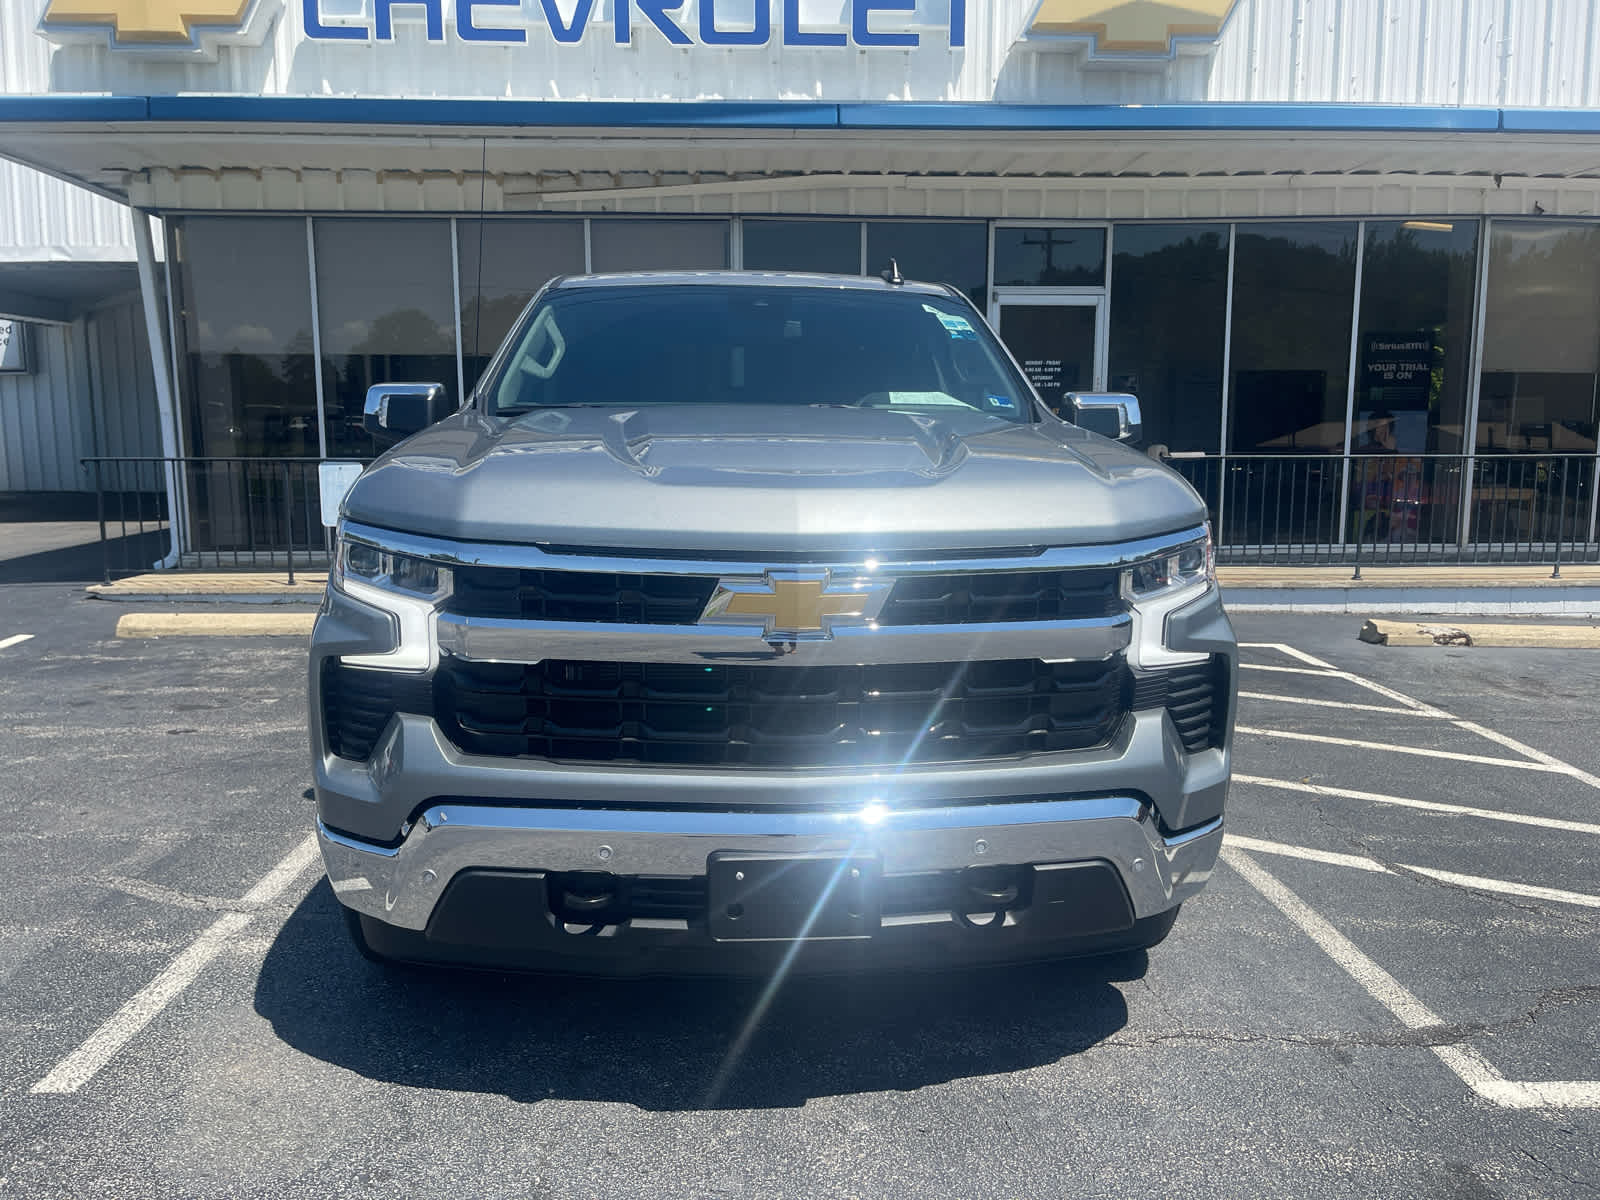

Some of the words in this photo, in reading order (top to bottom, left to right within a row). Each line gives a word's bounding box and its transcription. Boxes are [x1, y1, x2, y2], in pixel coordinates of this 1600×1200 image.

[1368, 363, 1397, 372] YOUR
[1399, 363, 1429, 371] TRIAL
[1396, 371, 1413, 380] ON
